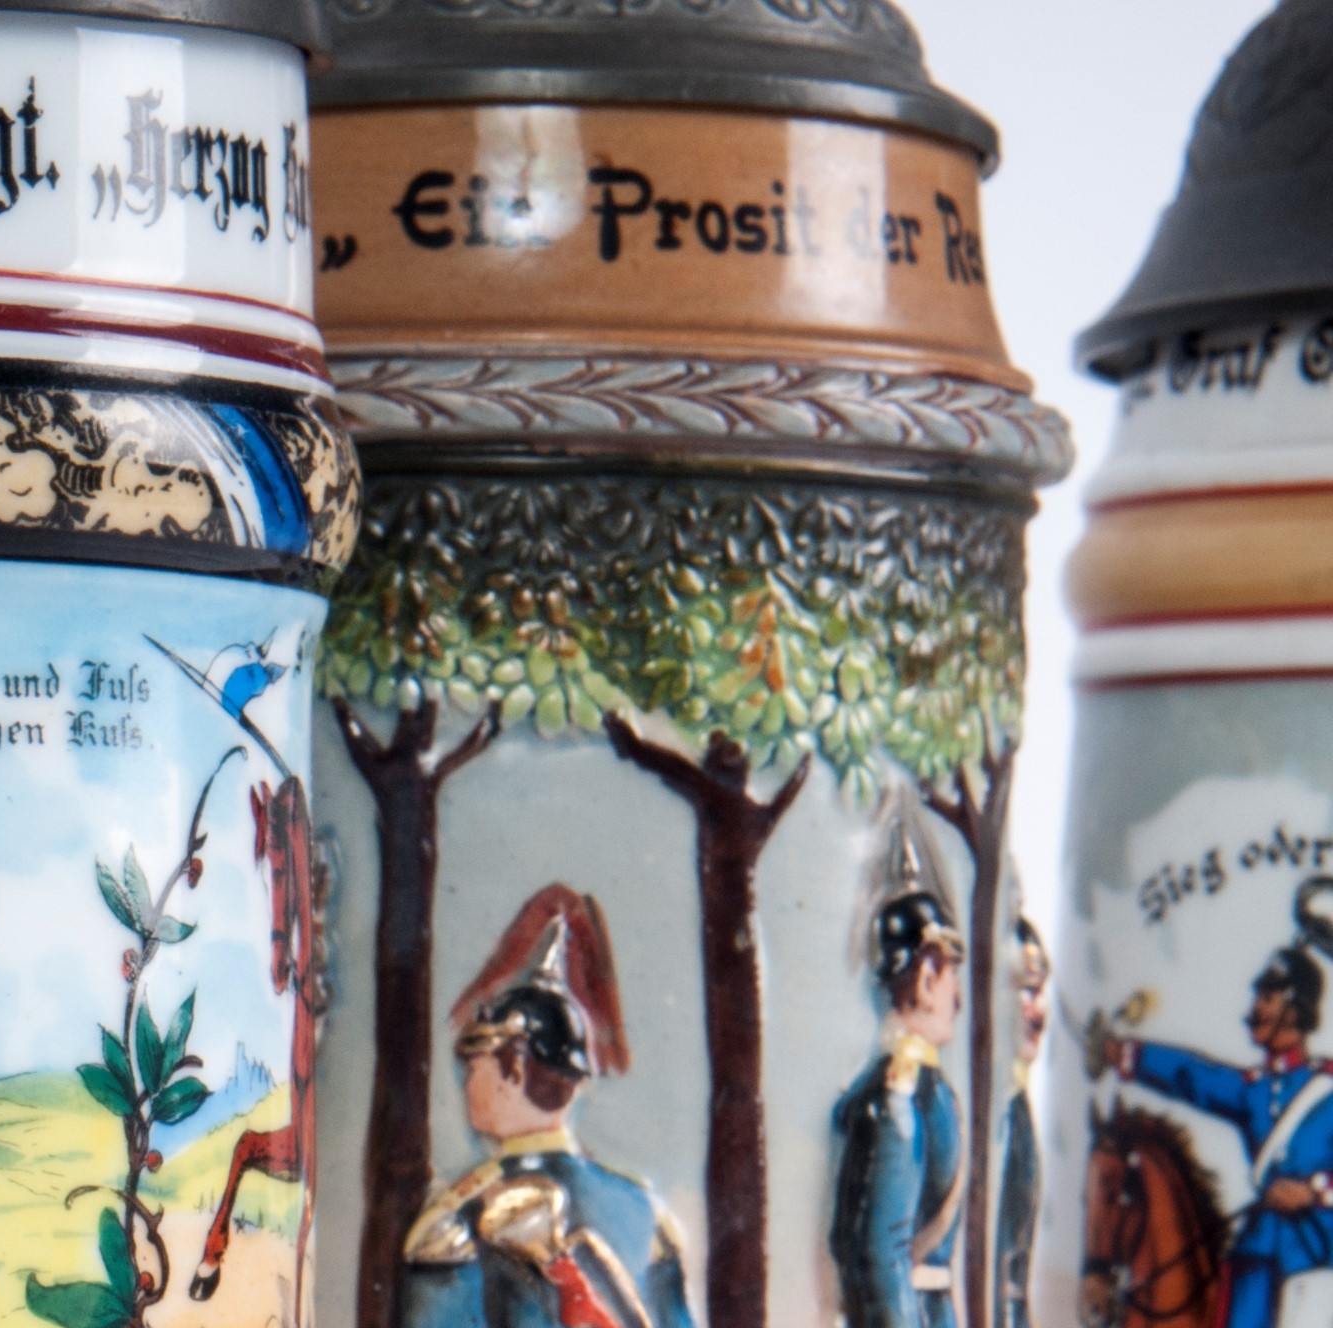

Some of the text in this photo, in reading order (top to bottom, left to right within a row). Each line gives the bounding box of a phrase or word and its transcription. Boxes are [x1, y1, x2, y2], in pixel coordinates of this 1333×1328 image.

[587, 168, 822, 263] Prosit
[847, 185, 922, 265] der
[2, 662, 61, 699] und
